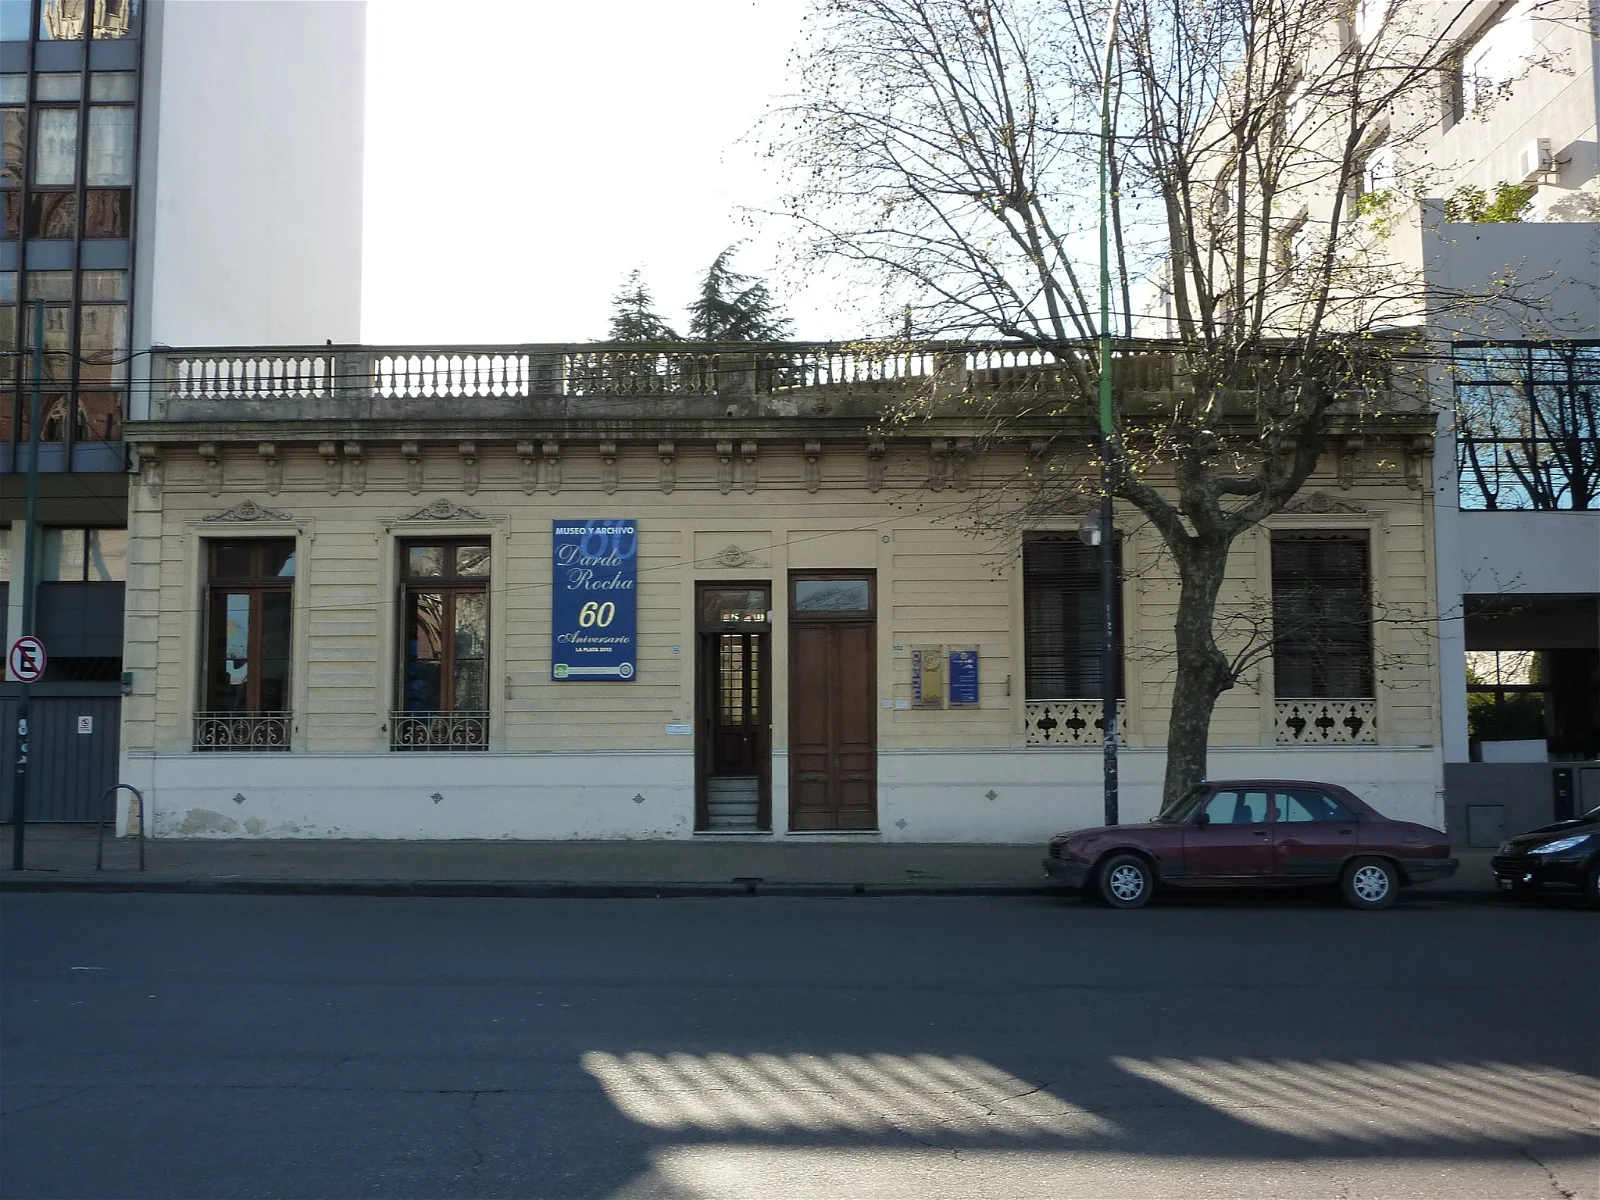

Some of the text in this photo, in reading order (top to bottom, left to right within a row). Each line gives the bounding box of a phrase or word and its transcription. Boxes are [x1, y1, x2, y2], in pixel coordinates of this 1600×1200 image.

[555, 527, 586, 535] MUSEO
[595, 527, 634, 535] ARCHIVO
[554, 543, 623, 567] Dardo
[567, 567, 633, 590] Rocha
[579, 601, 616, 628] 60
[557, 630, 631, 644] Aniversario
[20, 646, 36, 672] E
